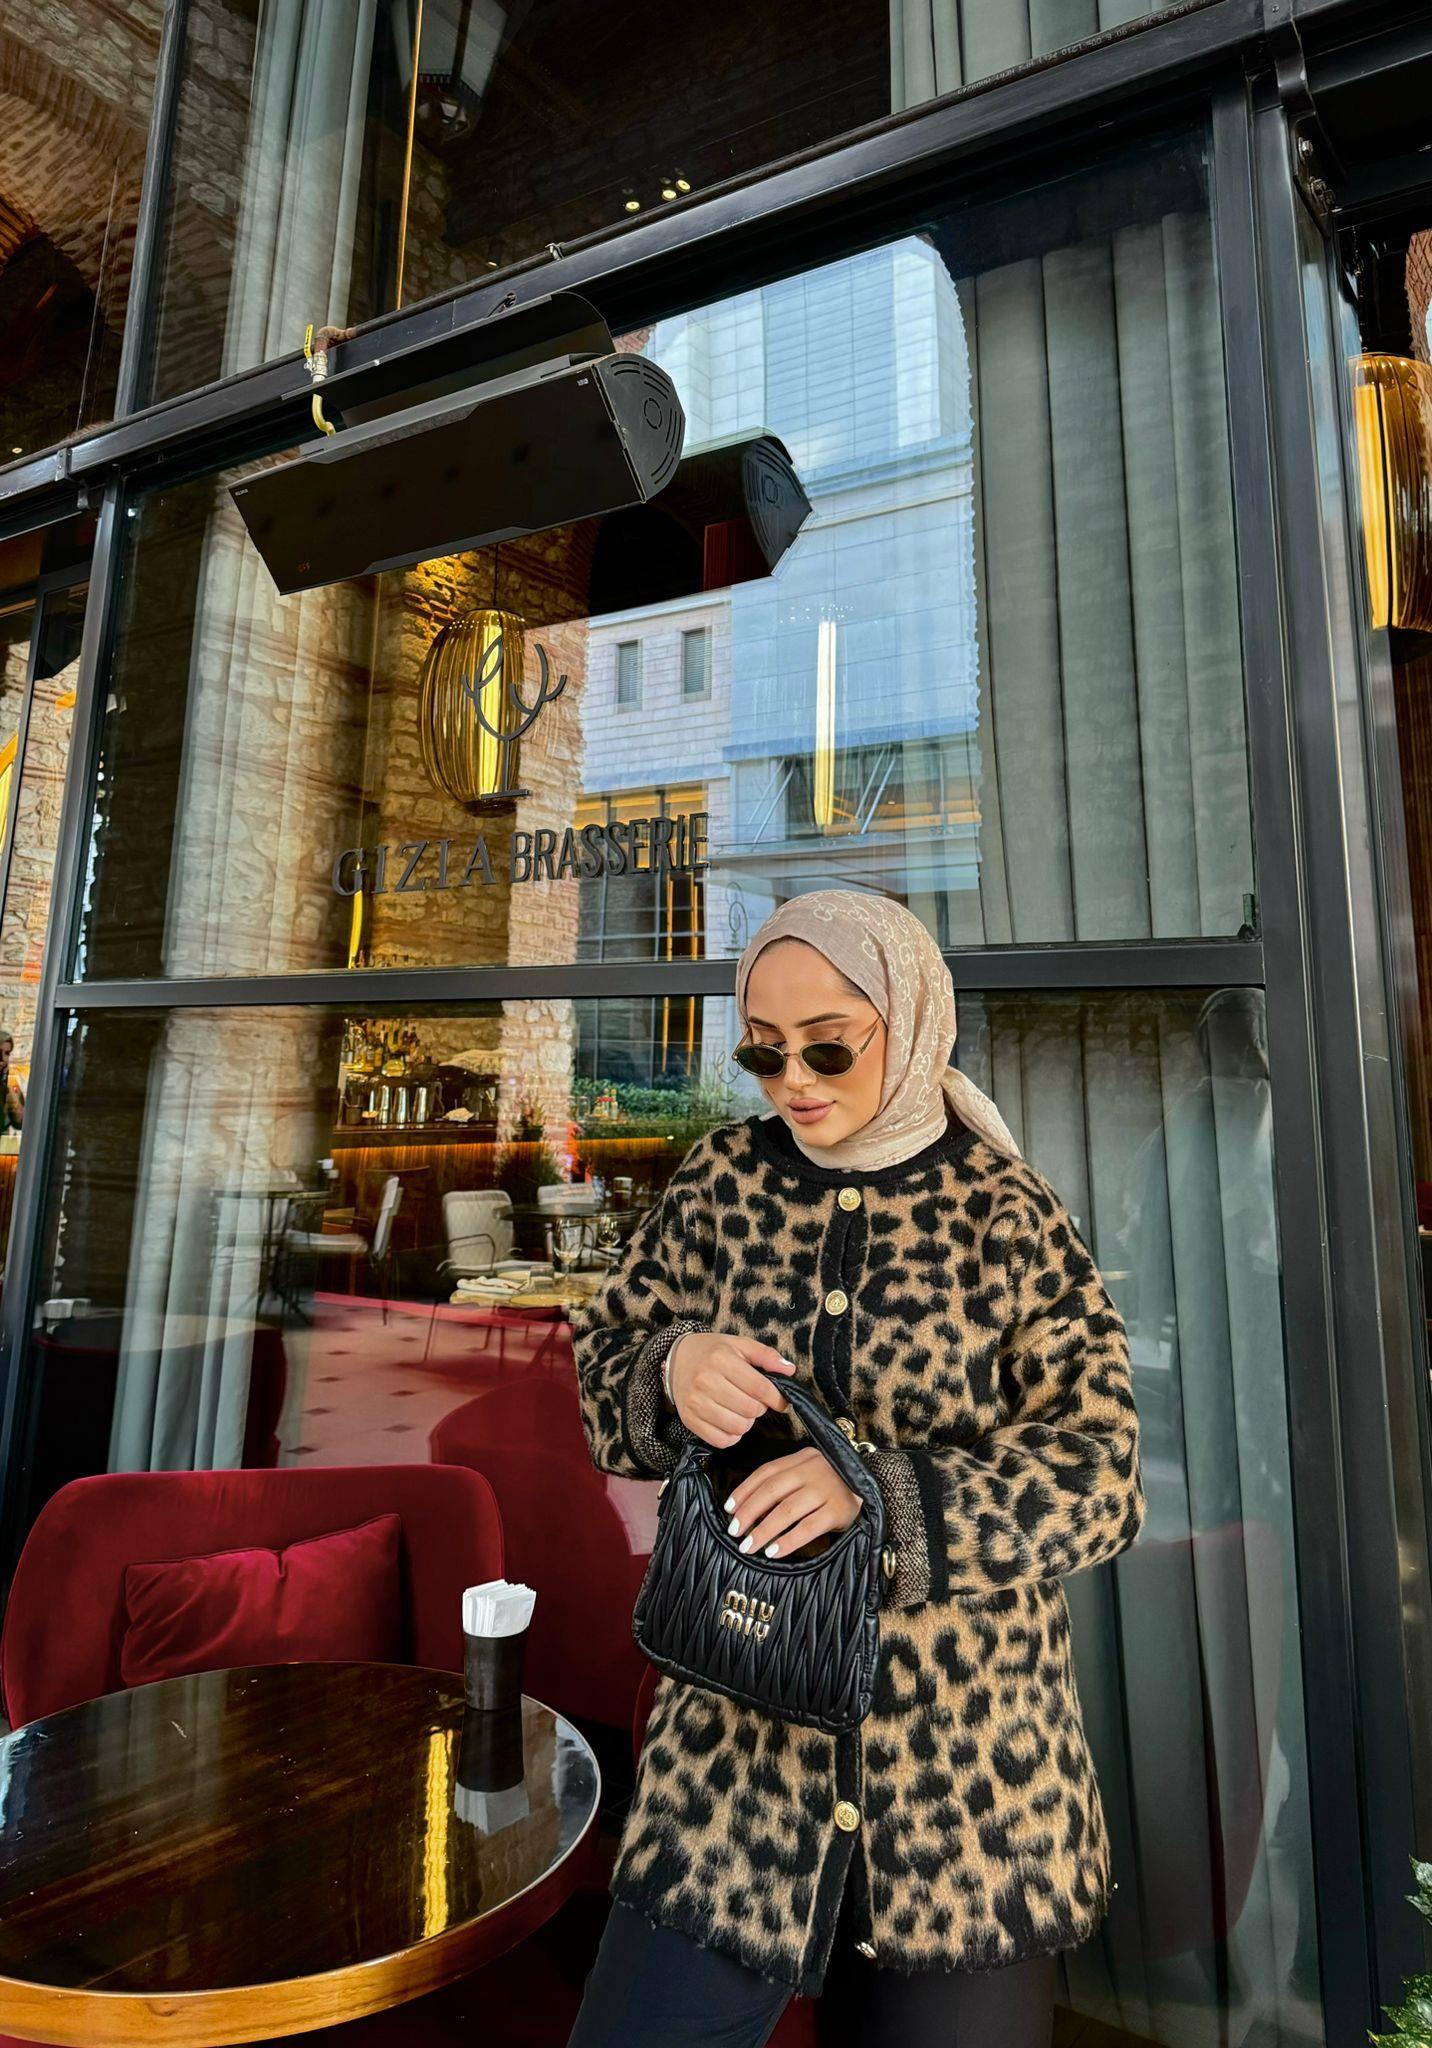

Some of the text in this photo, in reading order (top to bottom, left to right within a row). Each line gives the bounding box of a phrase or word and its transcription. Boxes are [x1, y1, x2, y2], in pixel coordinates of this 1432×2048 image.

[331, 812, 711, 897] GIZIA BRASSERIE
[723, 1590, 775, 1622] miu
[719, 1608, 770, 1642] miu
